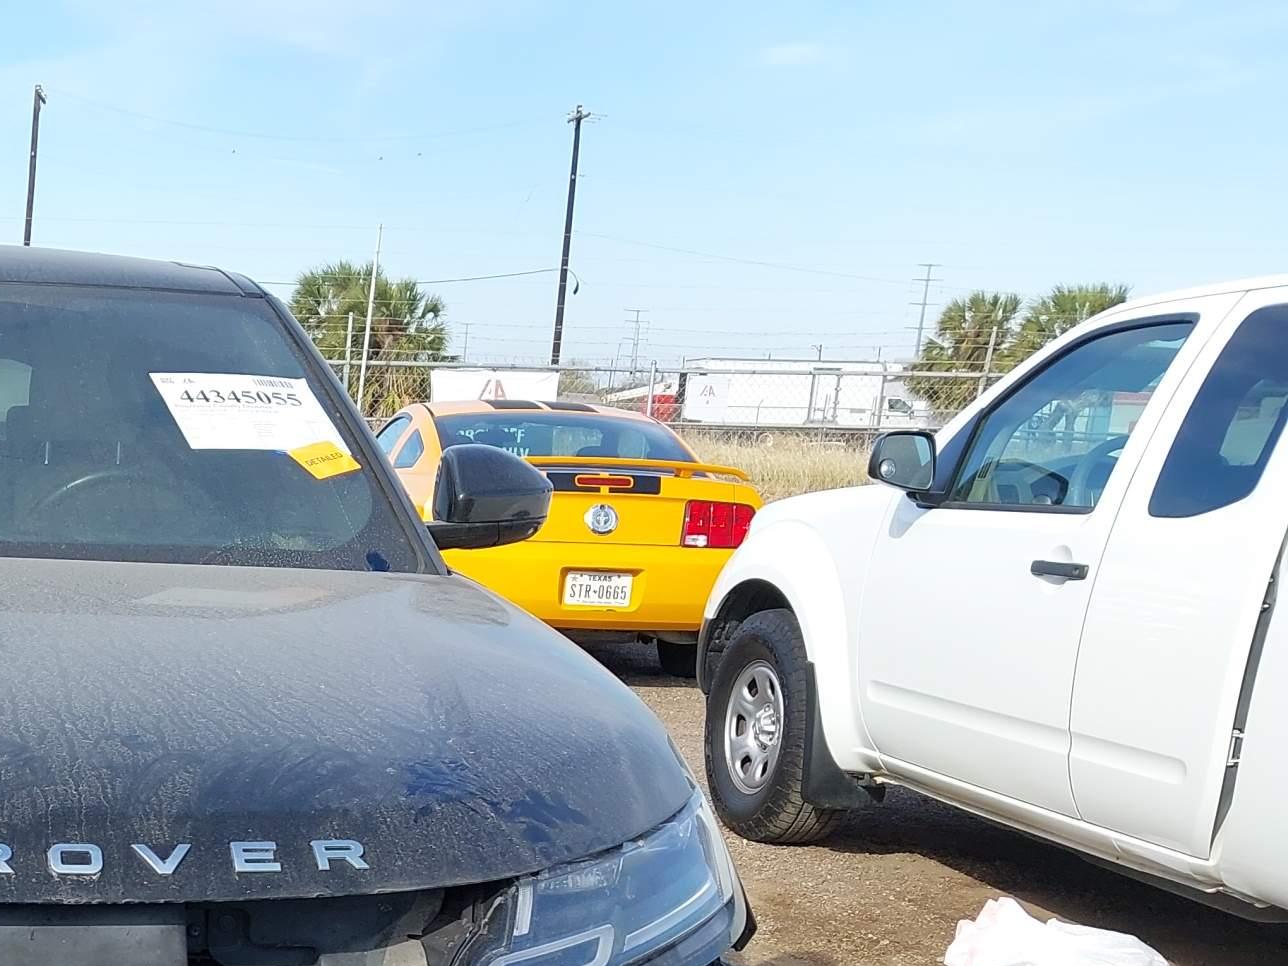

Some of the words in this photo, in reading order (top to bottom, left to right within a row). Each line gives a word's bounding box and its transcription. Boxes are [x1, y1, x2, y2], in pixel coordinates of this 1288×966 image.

[179, 389, 303, 407] 44345055
[304, 452, 344, 467] DETAILED
[587, 574, 614, 582] TEXAS
